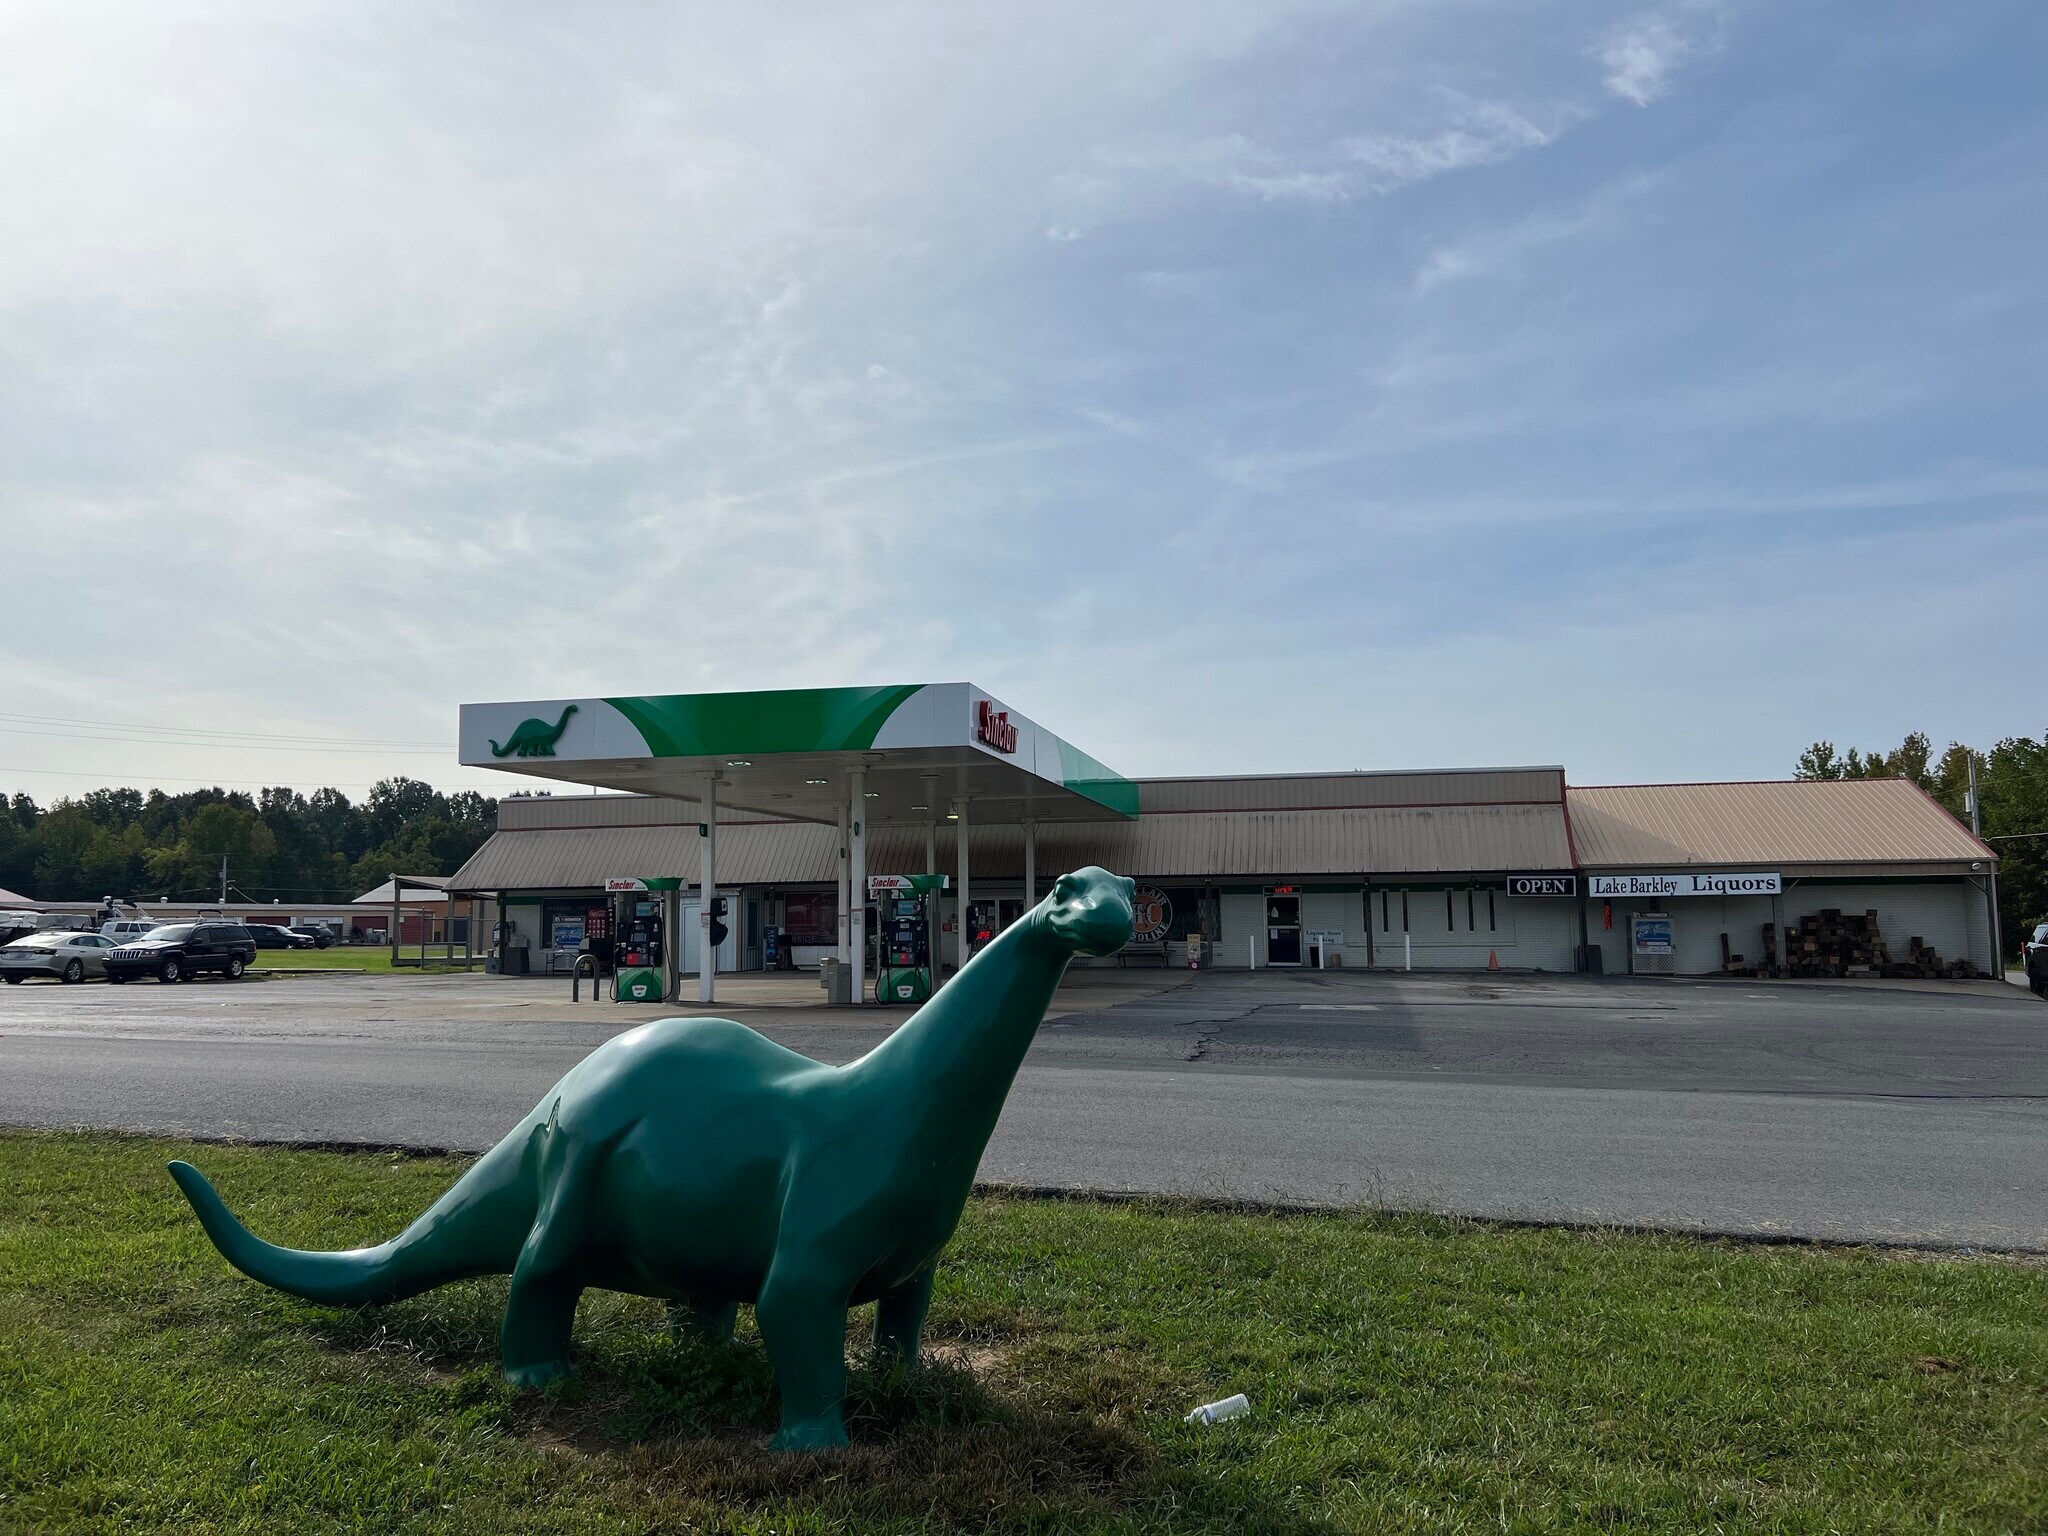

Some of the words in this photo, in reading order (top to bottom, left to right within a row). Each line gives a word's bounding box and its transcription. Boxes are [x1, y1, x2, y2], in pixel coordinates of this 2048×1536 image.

[978, 699, 1018, 753] Sinclair
[608, 880, 635, 890] Sinclair
[871, 877, 899, 888] Sinclair
[1516, 879, 1567, 894] OPEN
[1594, 878, 1627, 894] Lake
[1629, 877, 1678, 896] Barkley
[1691, 875, 1776, 894] Liquors
[1131, 920, 1169, 941] SOLINE
